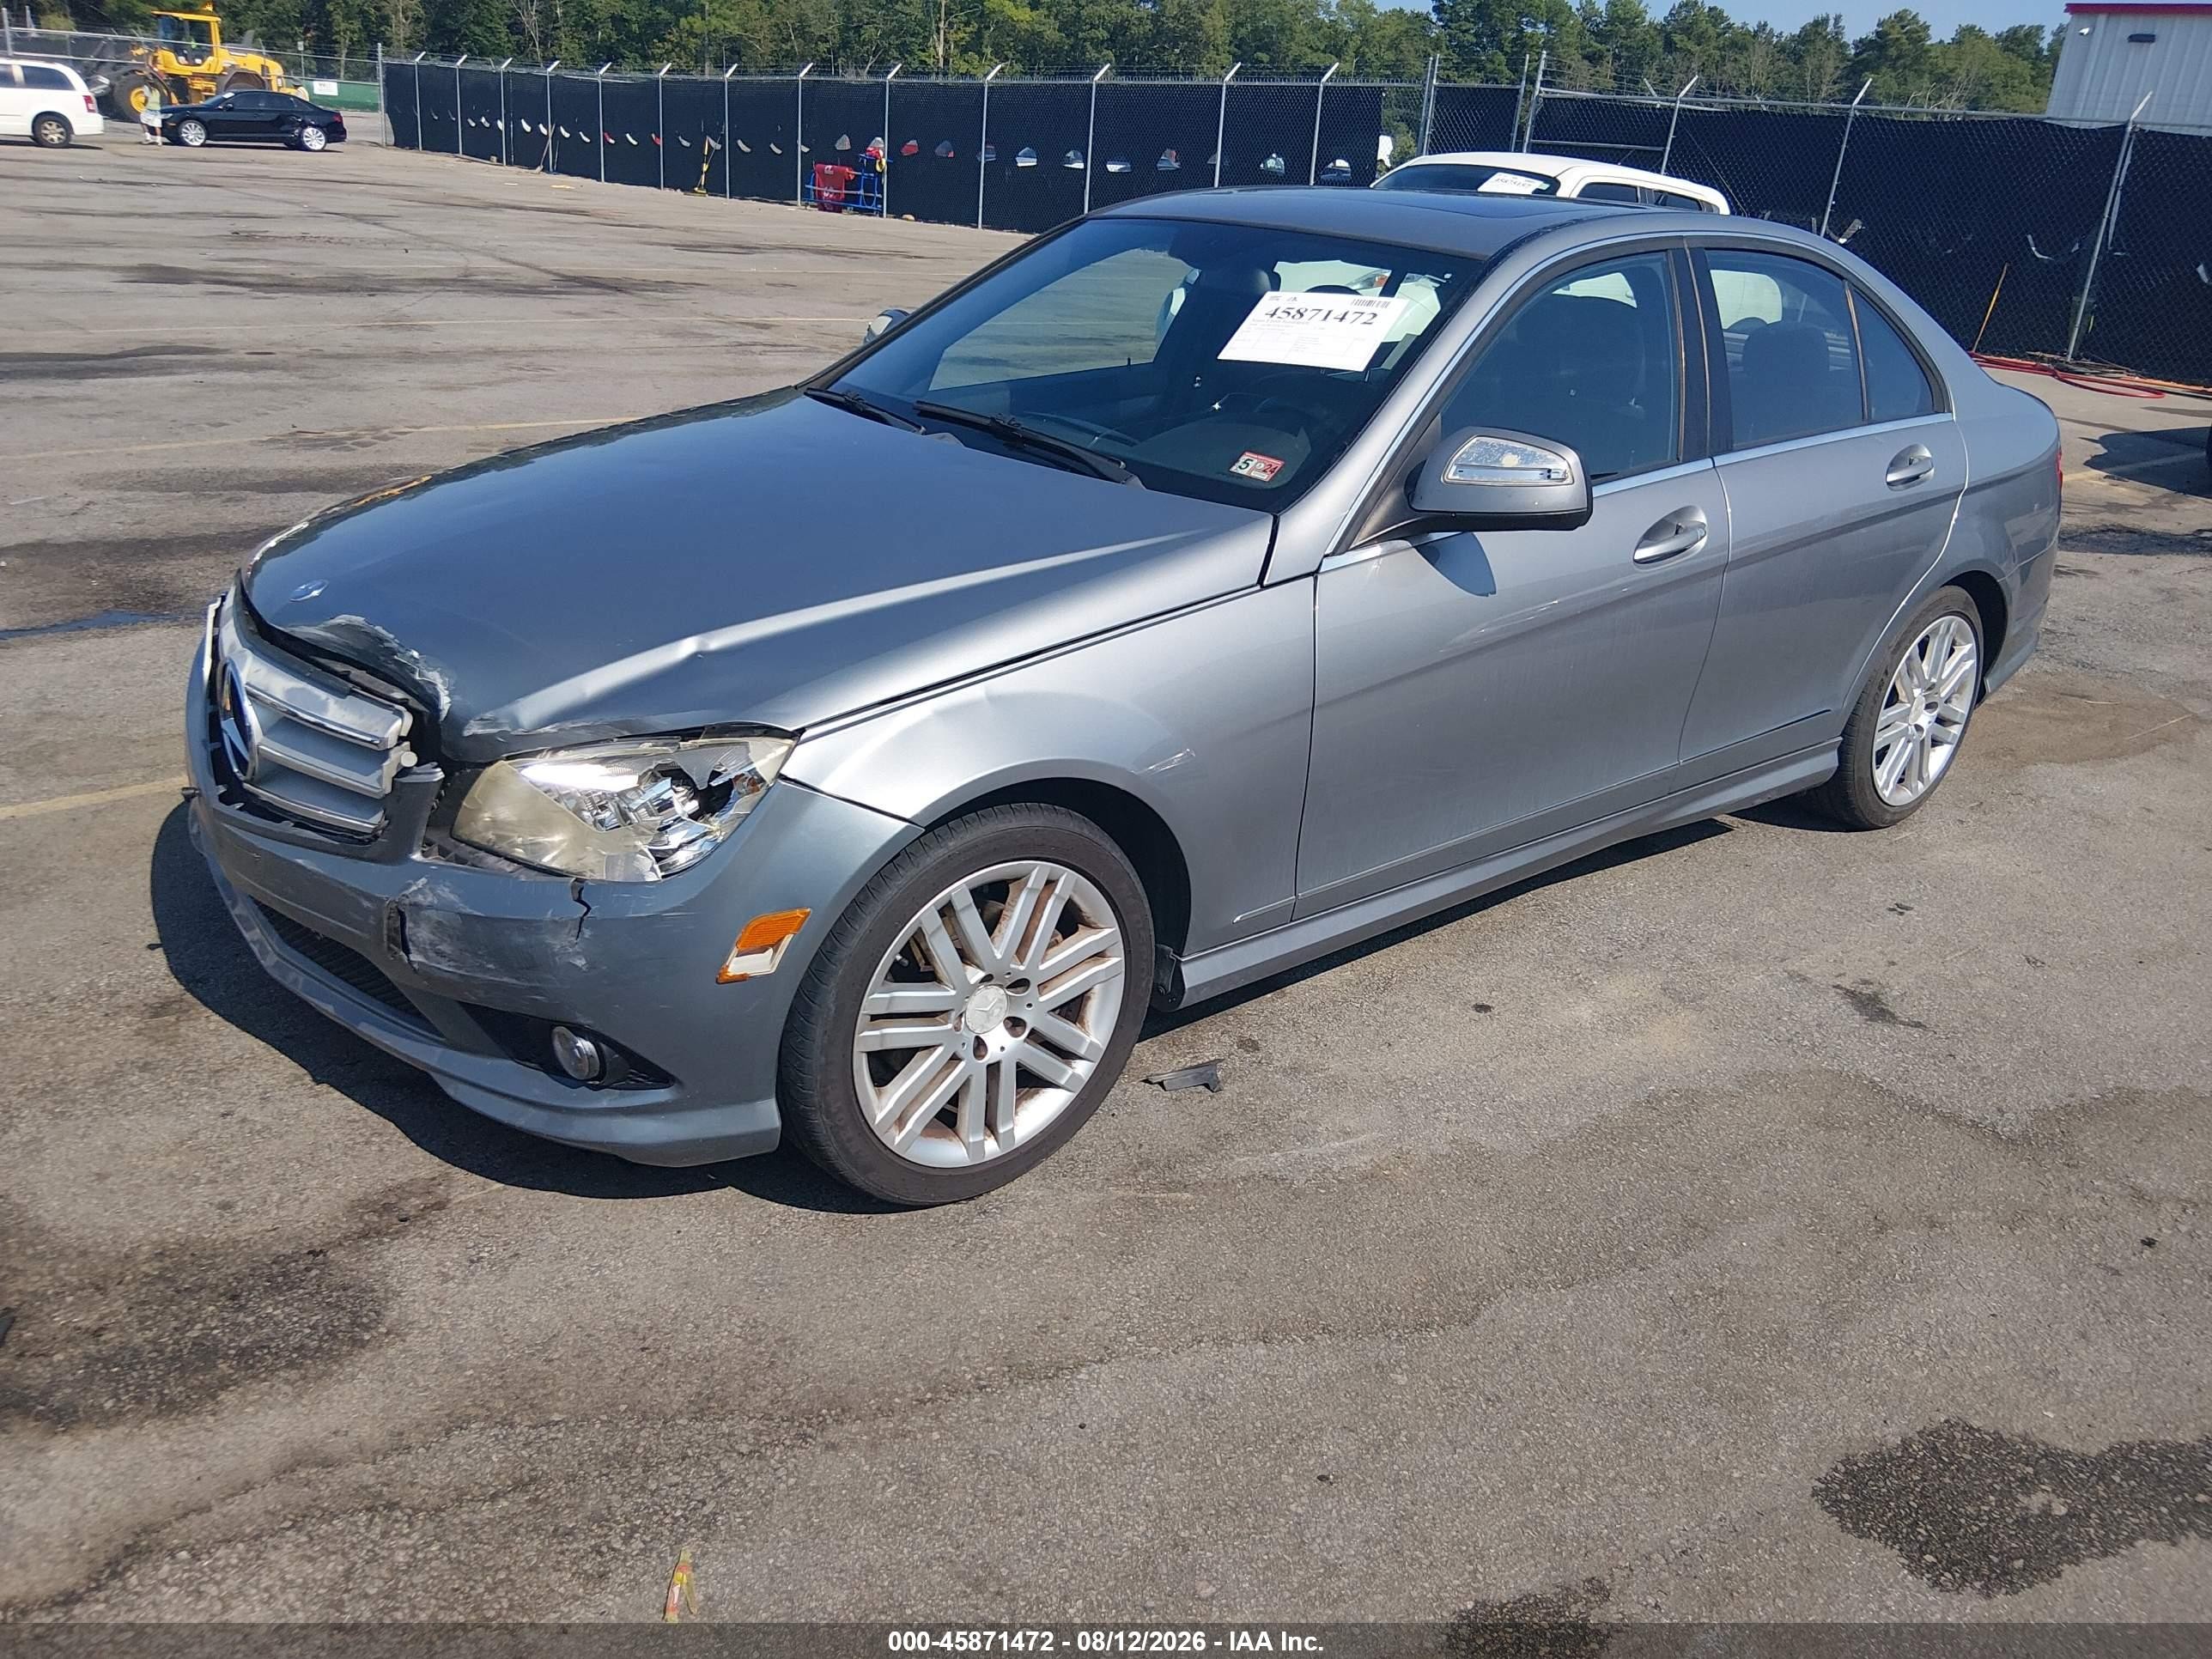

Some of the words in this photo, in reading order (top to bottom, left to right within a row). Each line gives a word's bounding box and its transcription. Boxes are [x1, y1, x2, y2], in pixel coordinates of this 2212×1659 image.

[1265, 306, 1378, 325] 45871472
[1238, 459, 1254, 470] 5
[1262, 464, 1279, 474] 24
